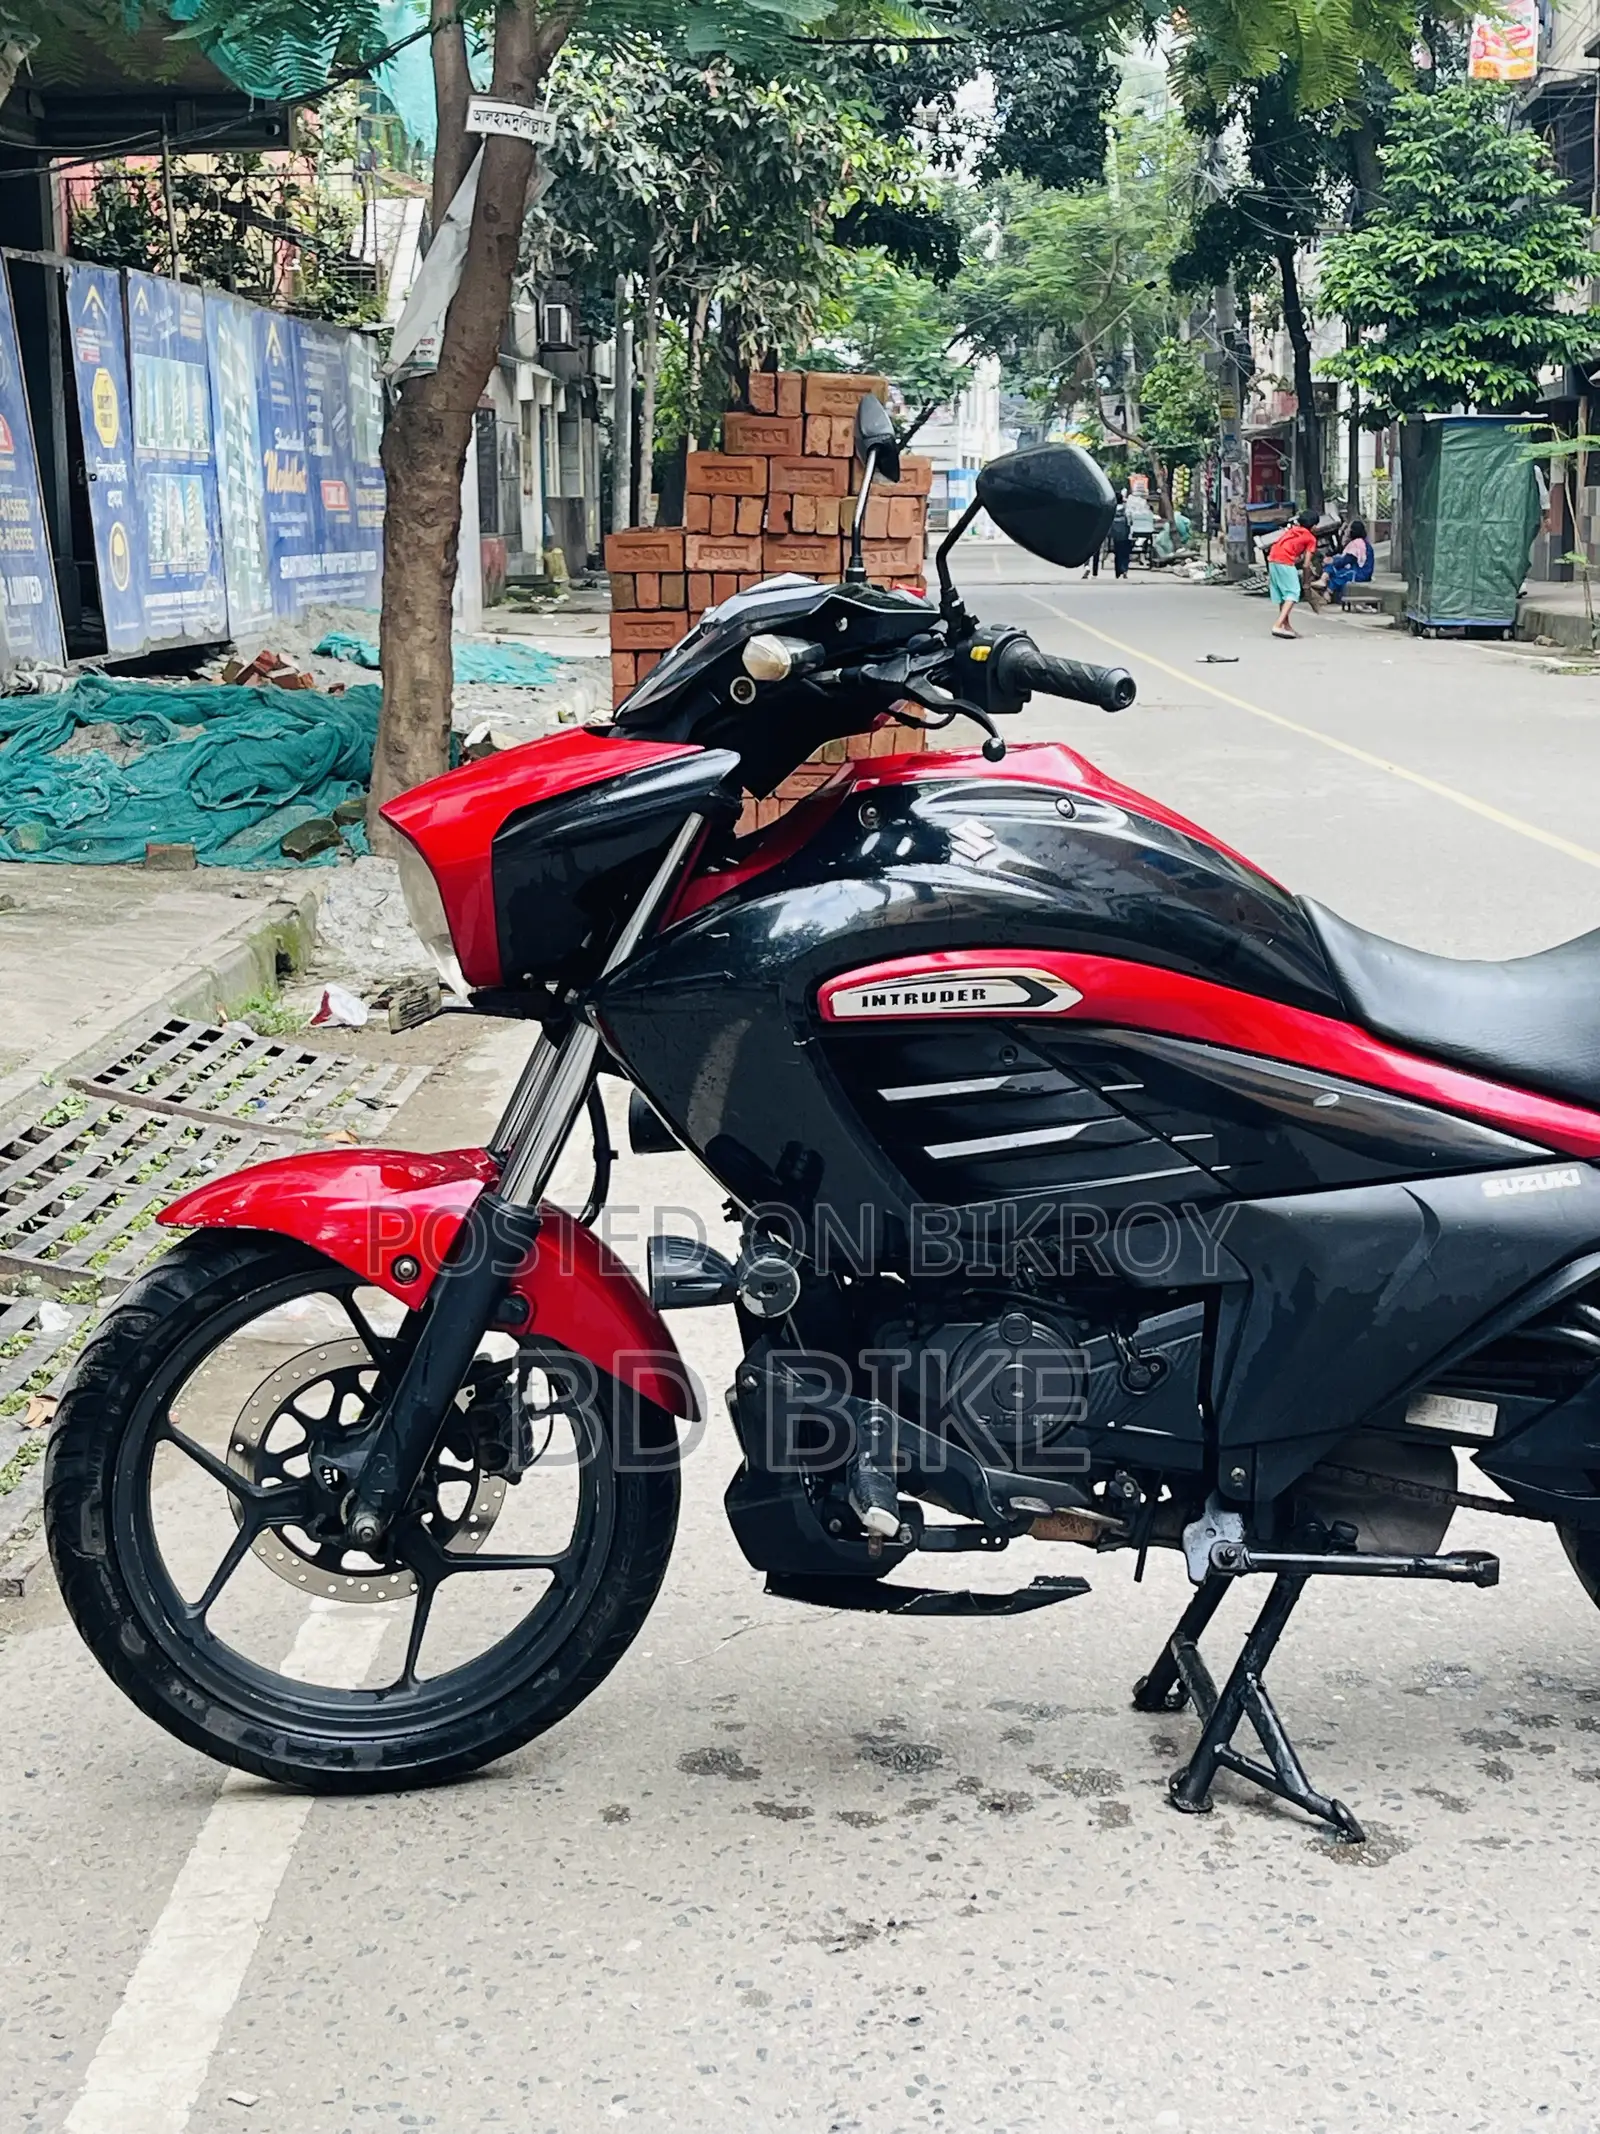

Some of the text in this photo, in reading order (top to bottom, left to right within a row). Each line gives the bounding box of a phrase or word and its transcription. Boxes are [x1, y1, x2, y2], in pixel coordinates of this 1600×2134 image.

[472, 108, 552, 137] আলহামদুলিল্লাহ
[861, 988, 987, 1008] INTRUDER
[1480, 1168, 1582, 1198] SUZUKI
